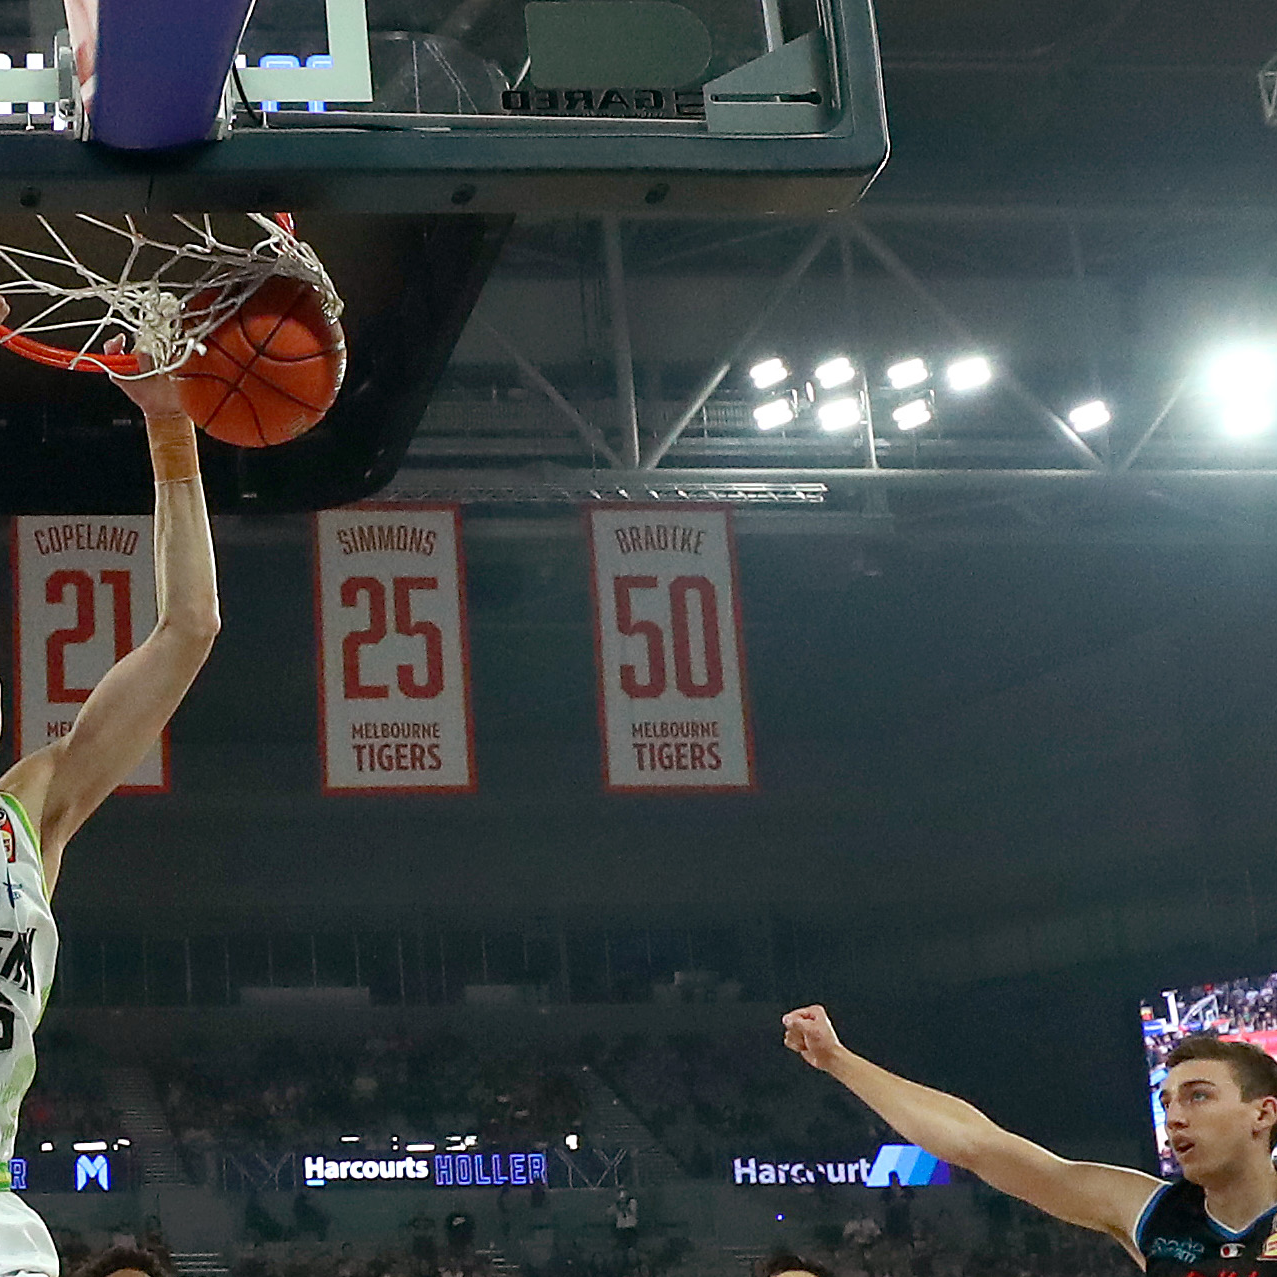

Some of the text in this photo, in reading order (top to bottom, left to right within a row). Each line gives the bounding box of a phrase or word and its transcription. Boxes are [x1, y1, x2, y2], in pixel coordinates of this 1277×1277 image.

[33, 522, 139, 557] COPELAND
[336, 524, 437, 556] SIMMONS
[45, 569, 133, 704] 21
[340, 575, 444, 700] 25
[614, 575, 724, 700] 50
[351, 722, 441, 740] MELBOURNE
[632, 722, 720, 739] MELBOURNE
[353, 743, 443, 772] TIGERS
[633, 742, 722, 771] TIGERS
[304, 1154, 547, 1186] Harcourts HOLLER
